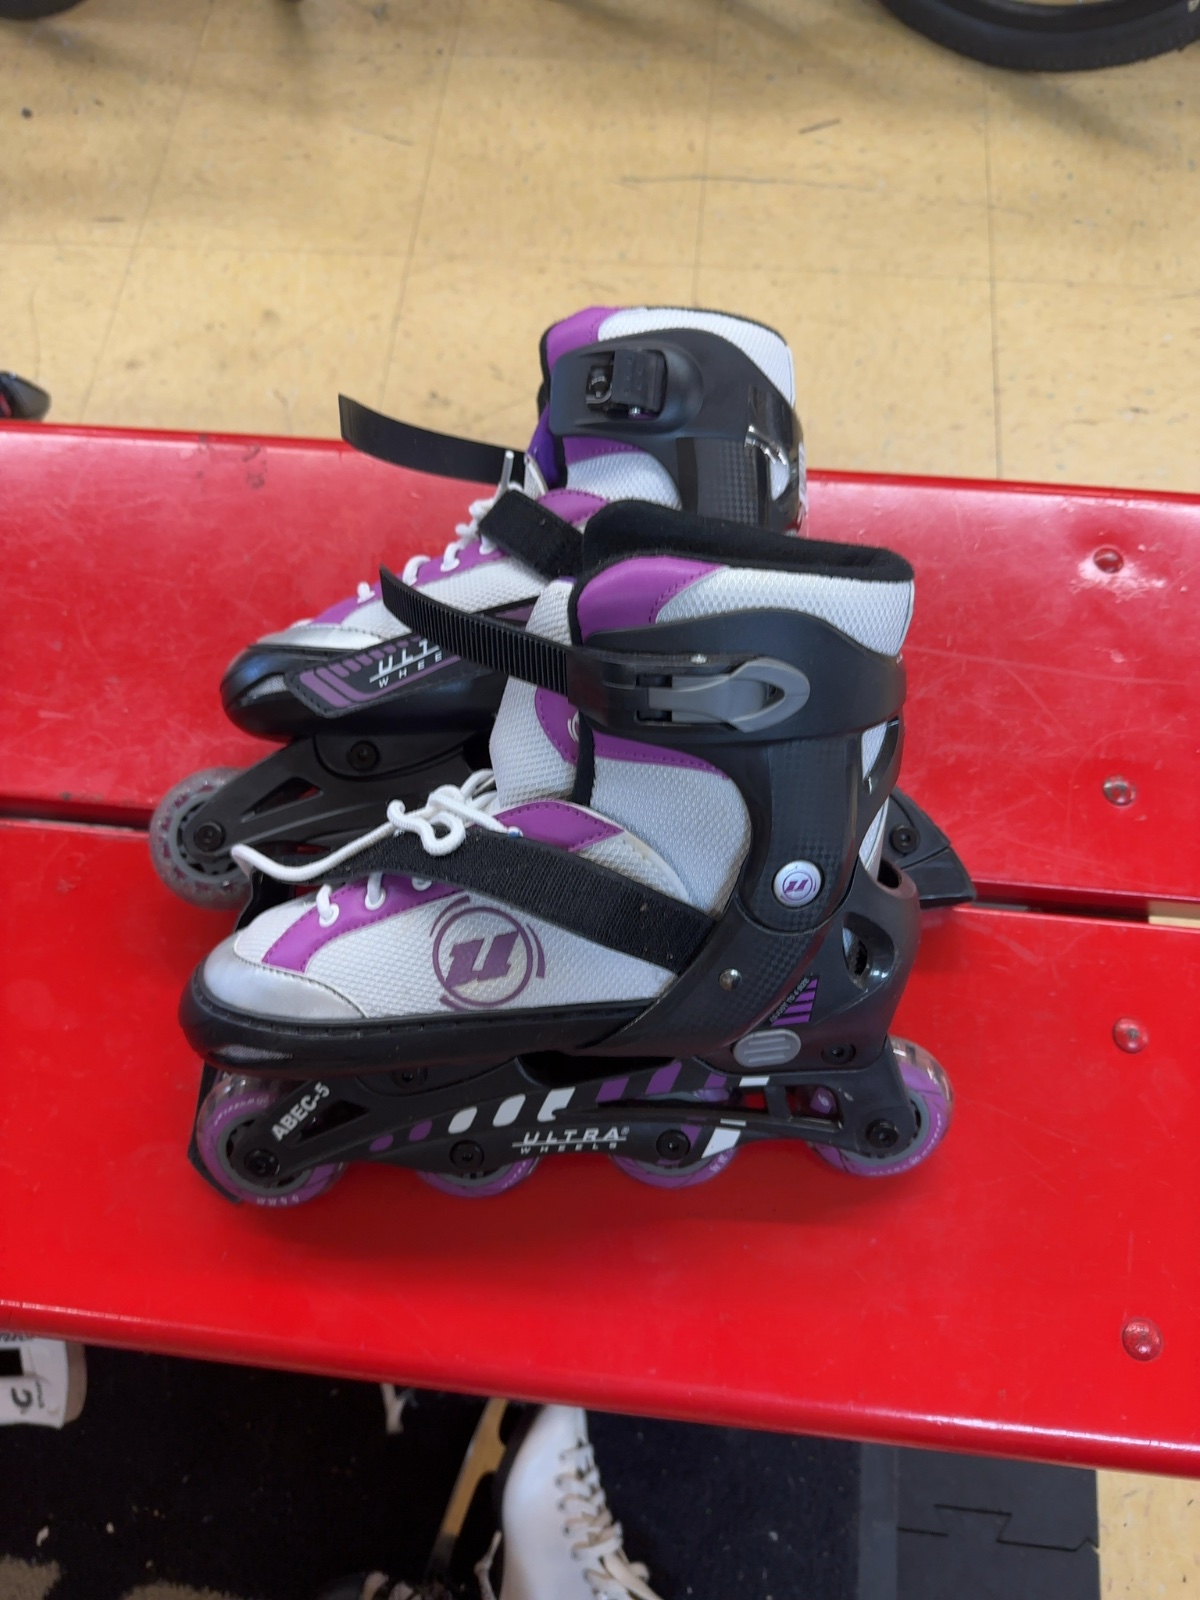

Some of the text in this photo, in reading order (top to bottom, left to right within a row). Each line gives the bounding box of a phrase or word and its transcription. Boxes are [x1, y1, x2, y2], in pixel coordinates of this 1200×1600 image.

[379, 638, 428, 676] ULT
[379, 650, 443, 688] WHEE
[271, 1081, 330, 1142] ABEC-5
